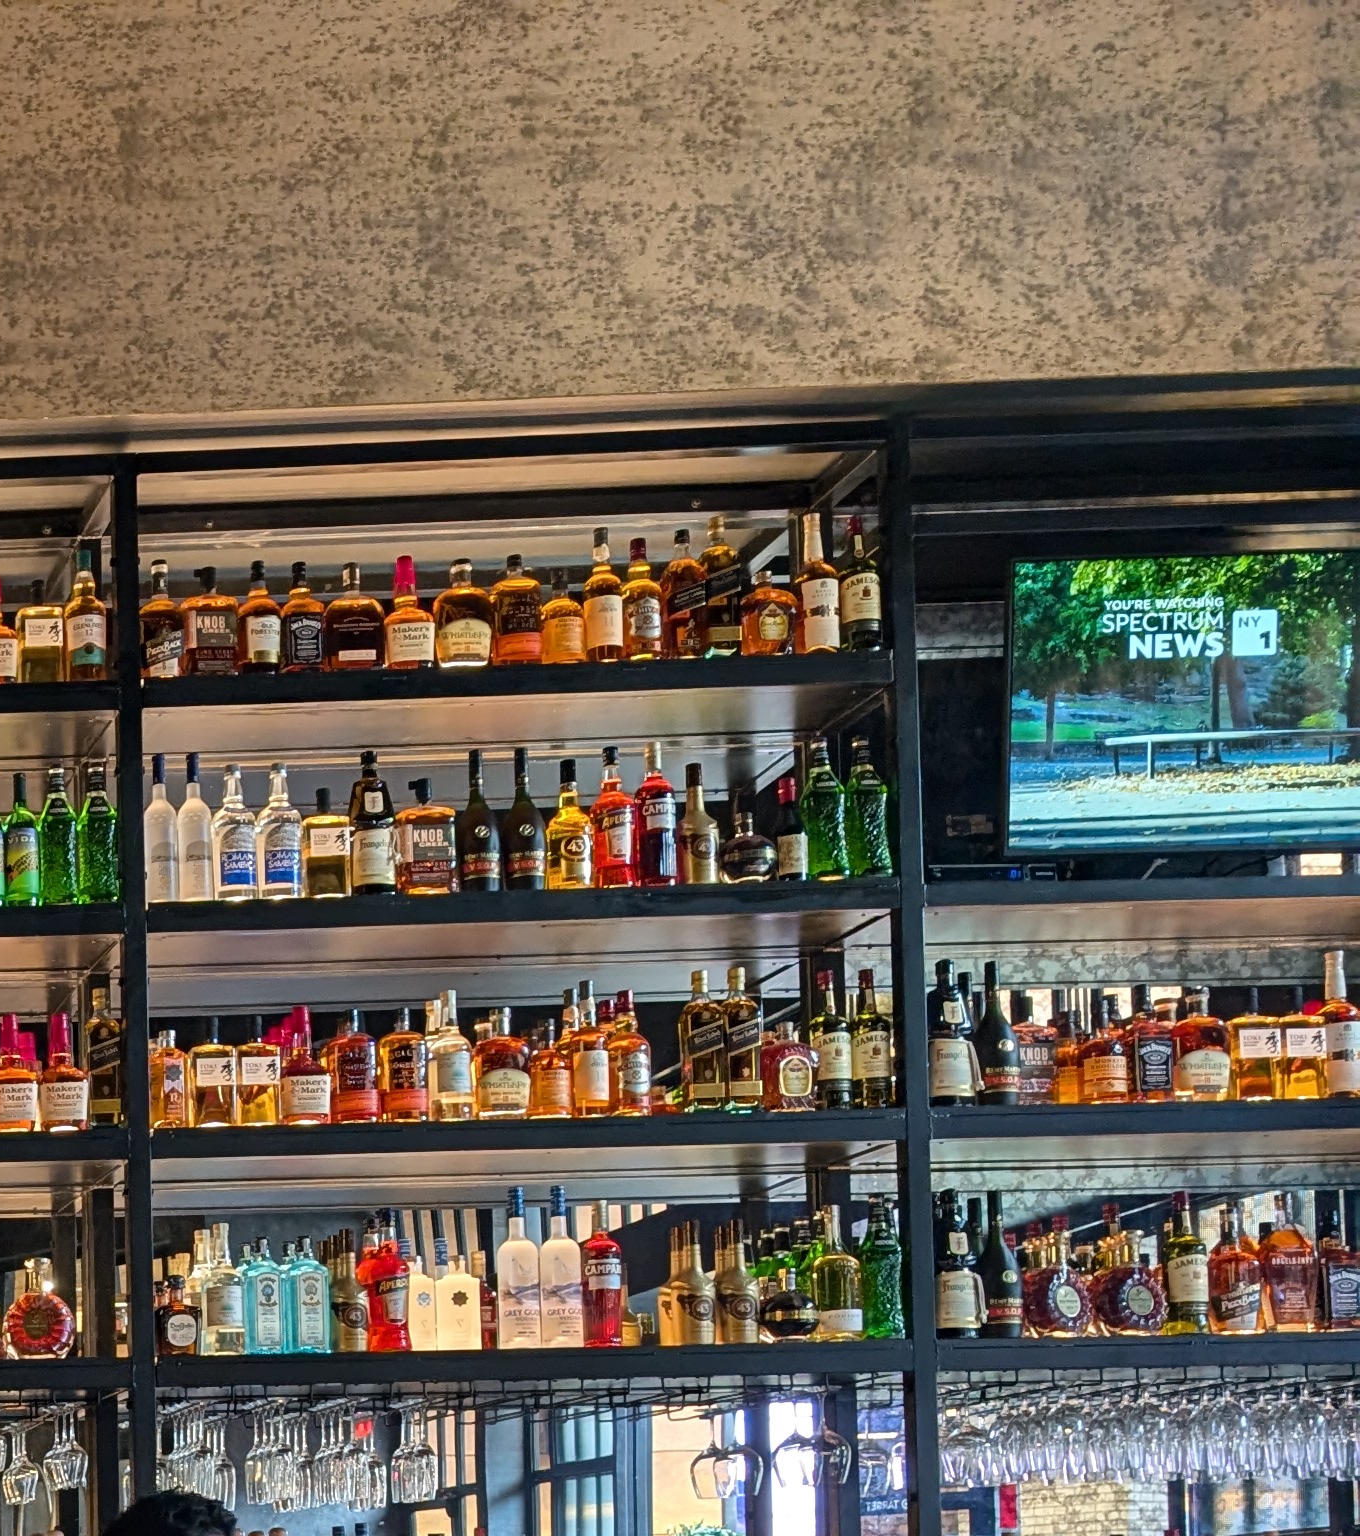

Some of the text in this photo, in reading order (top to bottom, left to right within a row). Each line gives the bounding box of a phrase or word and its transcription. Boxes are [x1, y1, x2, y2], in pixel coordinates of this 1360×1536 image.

[1104, 597, 1224, 611] YOU'RE WATCHING
[197, 616, 225, 628] KNOB
[1103, 612, 1224, 633] SPECTRUM
[1238, 616, 1261, 628] NY
[1130, 632, 1224, 659] NEWS
[1260, 631, 1271, 648] 1
[413, 829, 443, 841] KNOB
[567, 839, 585, 852] 43
[1020, 1047, 1049, 1061] KNOB
[290, 1079, 327, 1087] Maker's
[46, 1085, 83, 1094] Maker's
[6, 1093, 33, 1101] Mark
[57, 1092, 83, 1100] Mark
[504, 1308, 541, 1318] GREY GOO
[698, 1304, 711, 1314] 43
[737, 1303, 751, 1314] 43
